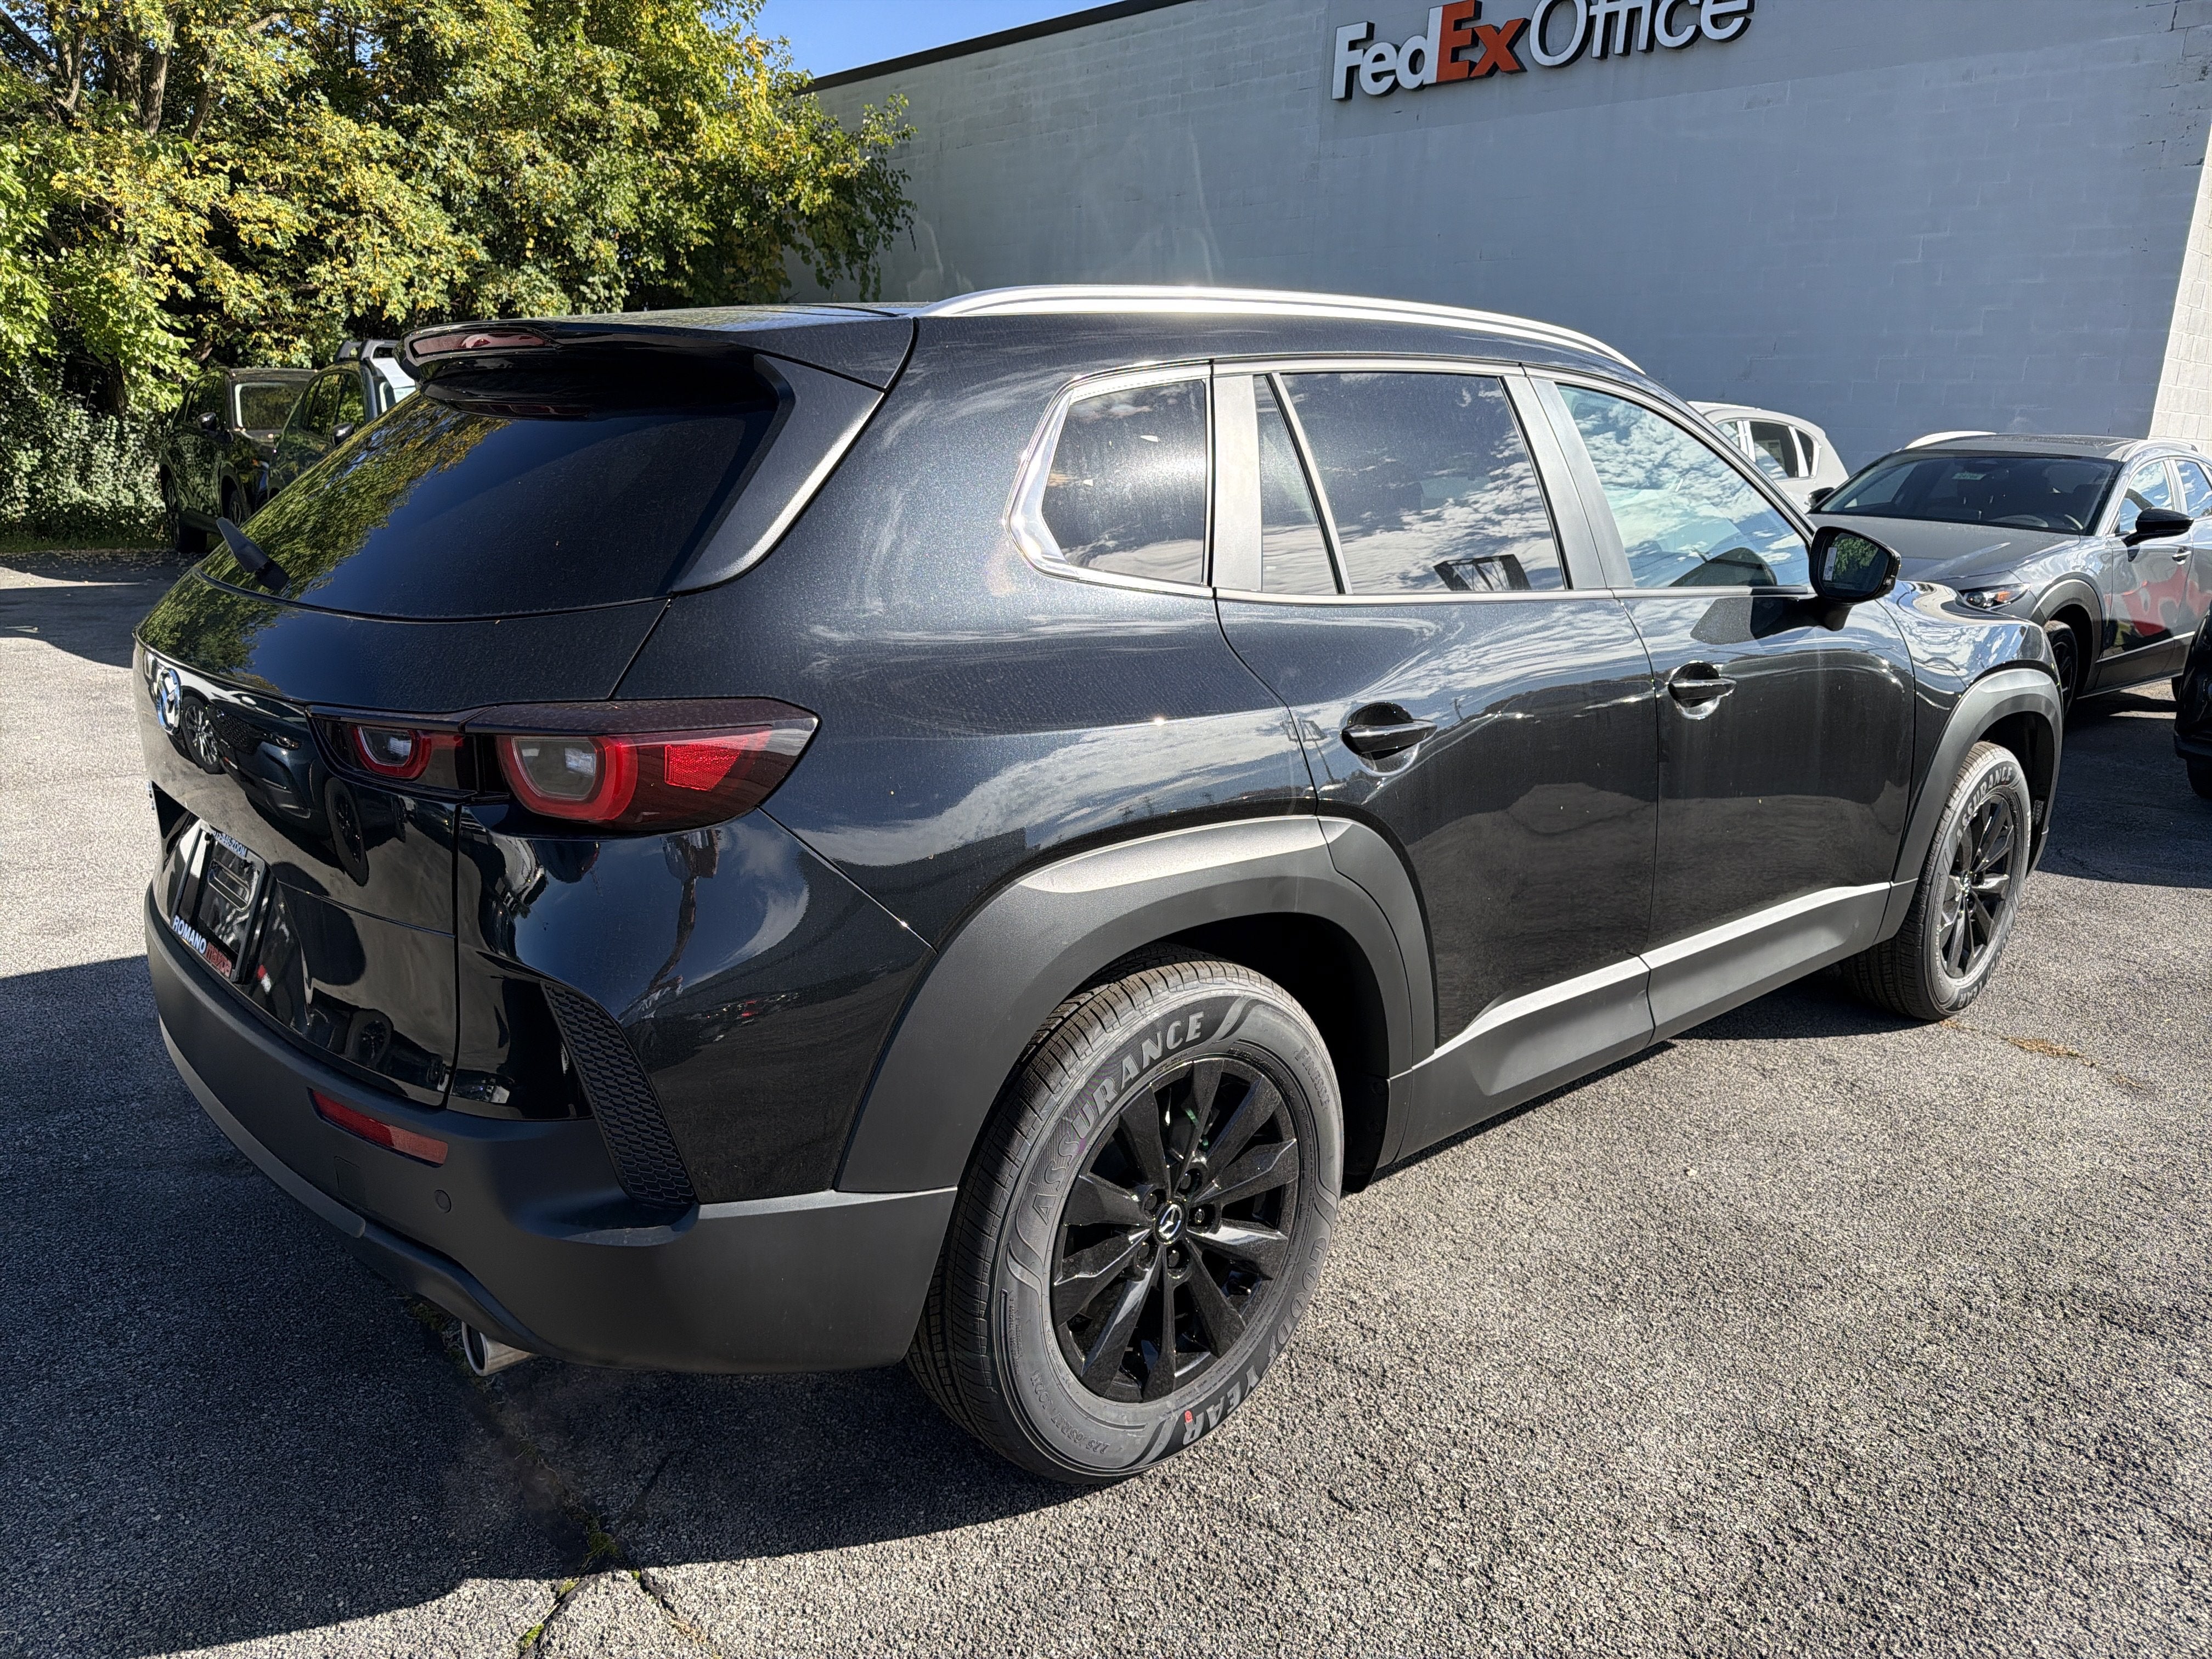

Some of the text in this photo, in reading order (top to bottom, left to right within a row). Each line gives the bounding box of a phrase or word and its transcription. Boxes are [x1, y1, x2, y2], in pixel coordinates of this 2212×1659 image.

[1957, 767, 2013, 844] ASSURANCE
[172, 915, 207, 955] ROMANO
[1295, 1045, 1330, 1109] FINESSE
[1027, 1014, 1203, 1224] ASSURANCE
